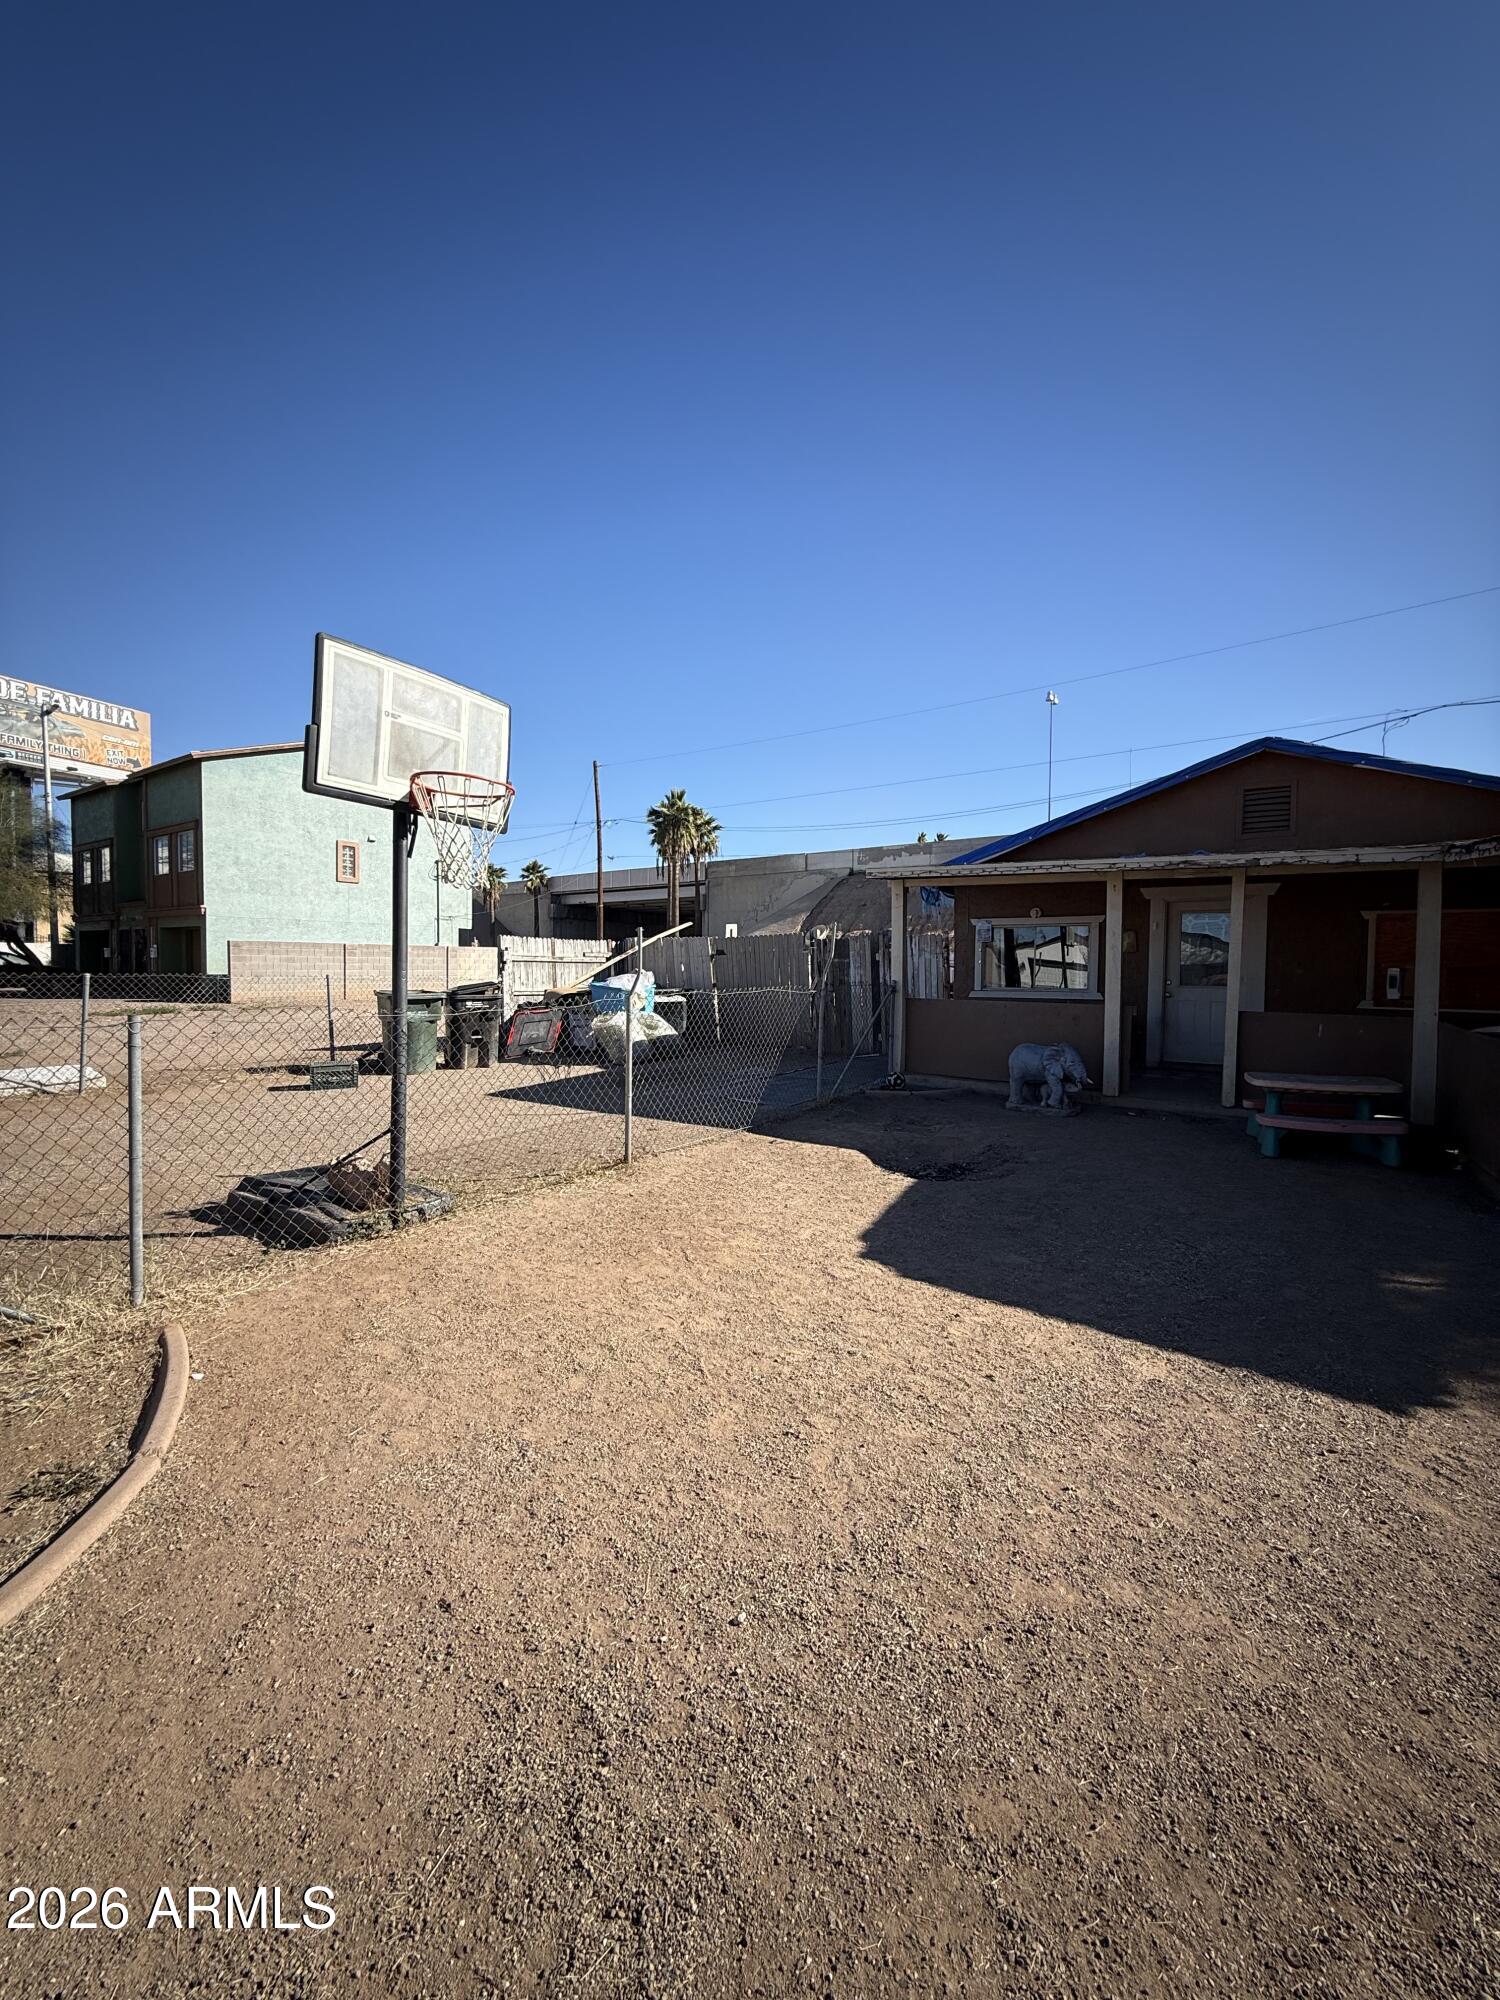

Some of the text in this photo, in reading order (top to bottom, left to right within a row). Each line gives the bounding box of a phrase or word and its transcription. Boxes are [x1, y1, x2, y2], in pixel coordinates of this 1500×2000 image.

[35, 686, 138, 731] FAMILIA
[0, 733, 43, 749] FAMILY
[106, 749, 124, 757] EXIT
[107, 757, 126, 765] NOW
